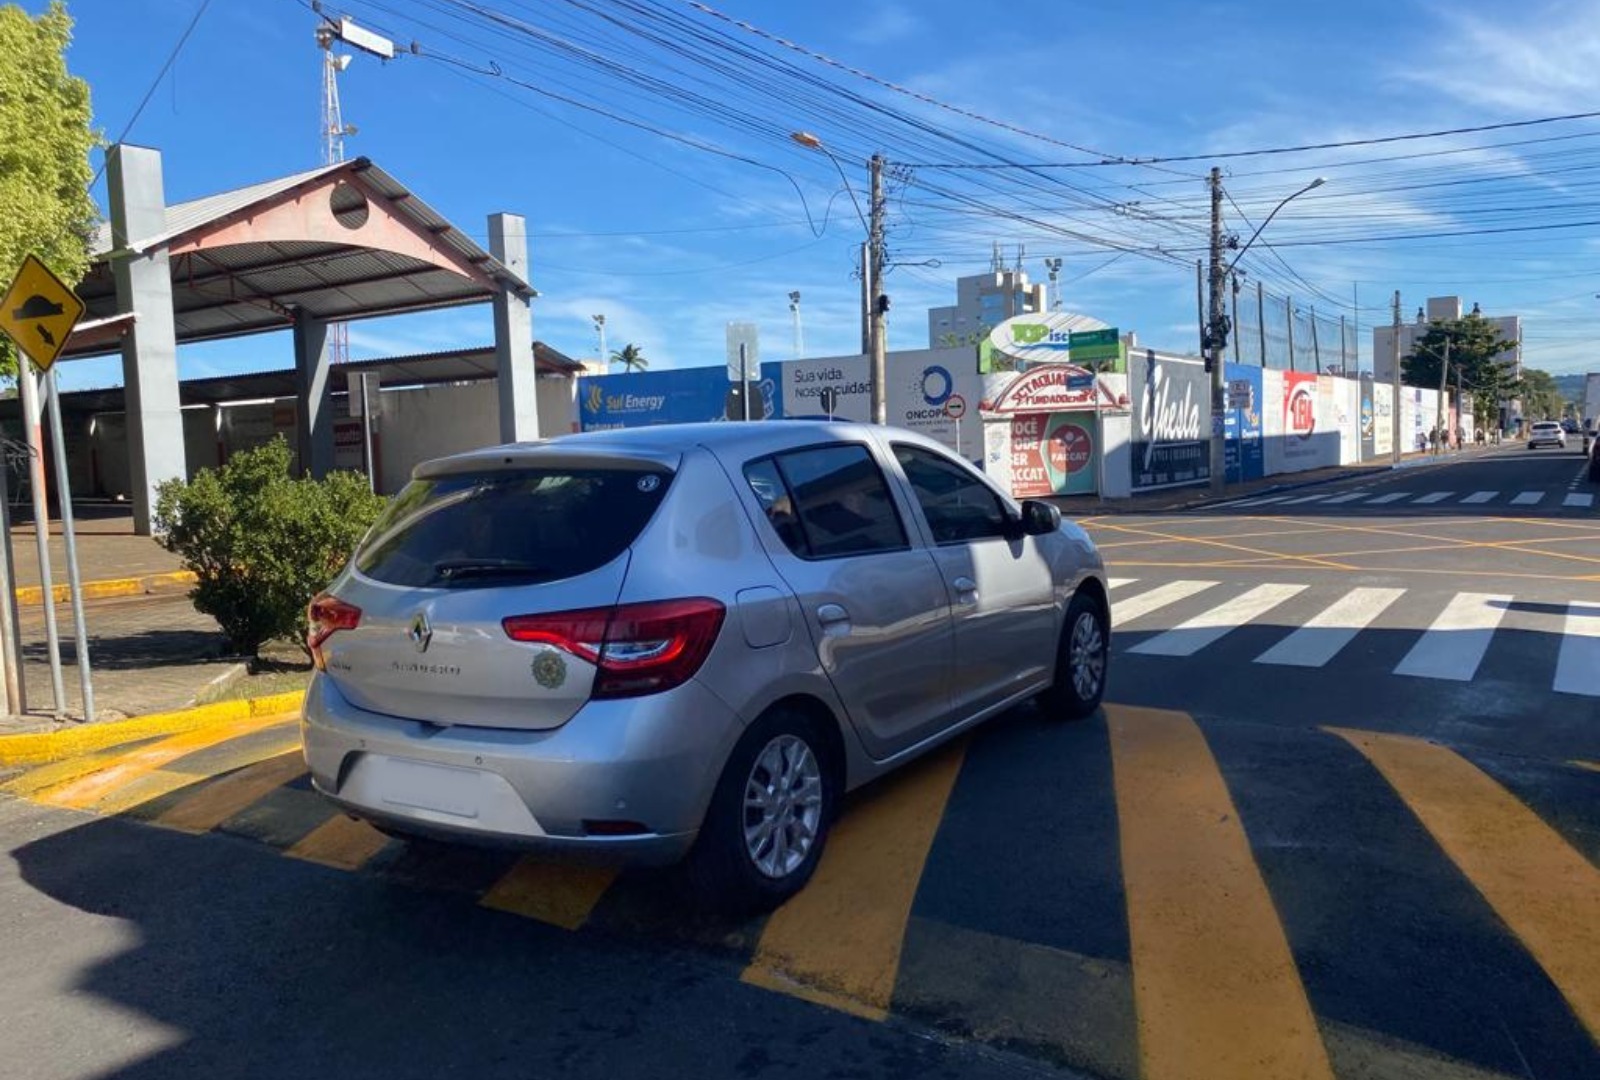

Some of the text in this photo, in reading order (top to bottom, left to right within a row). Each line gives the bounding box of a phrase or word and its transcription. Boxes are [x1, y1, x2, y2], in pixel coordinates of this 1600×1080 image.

[794, 369, 815, 384] Sua
[834, 382, 872, 395] cuidad
[606, 394, 665, 409] Sul Energy
[1012, 438, 1038, 451] ODE
[1011, 453, 1028, 466] ER
